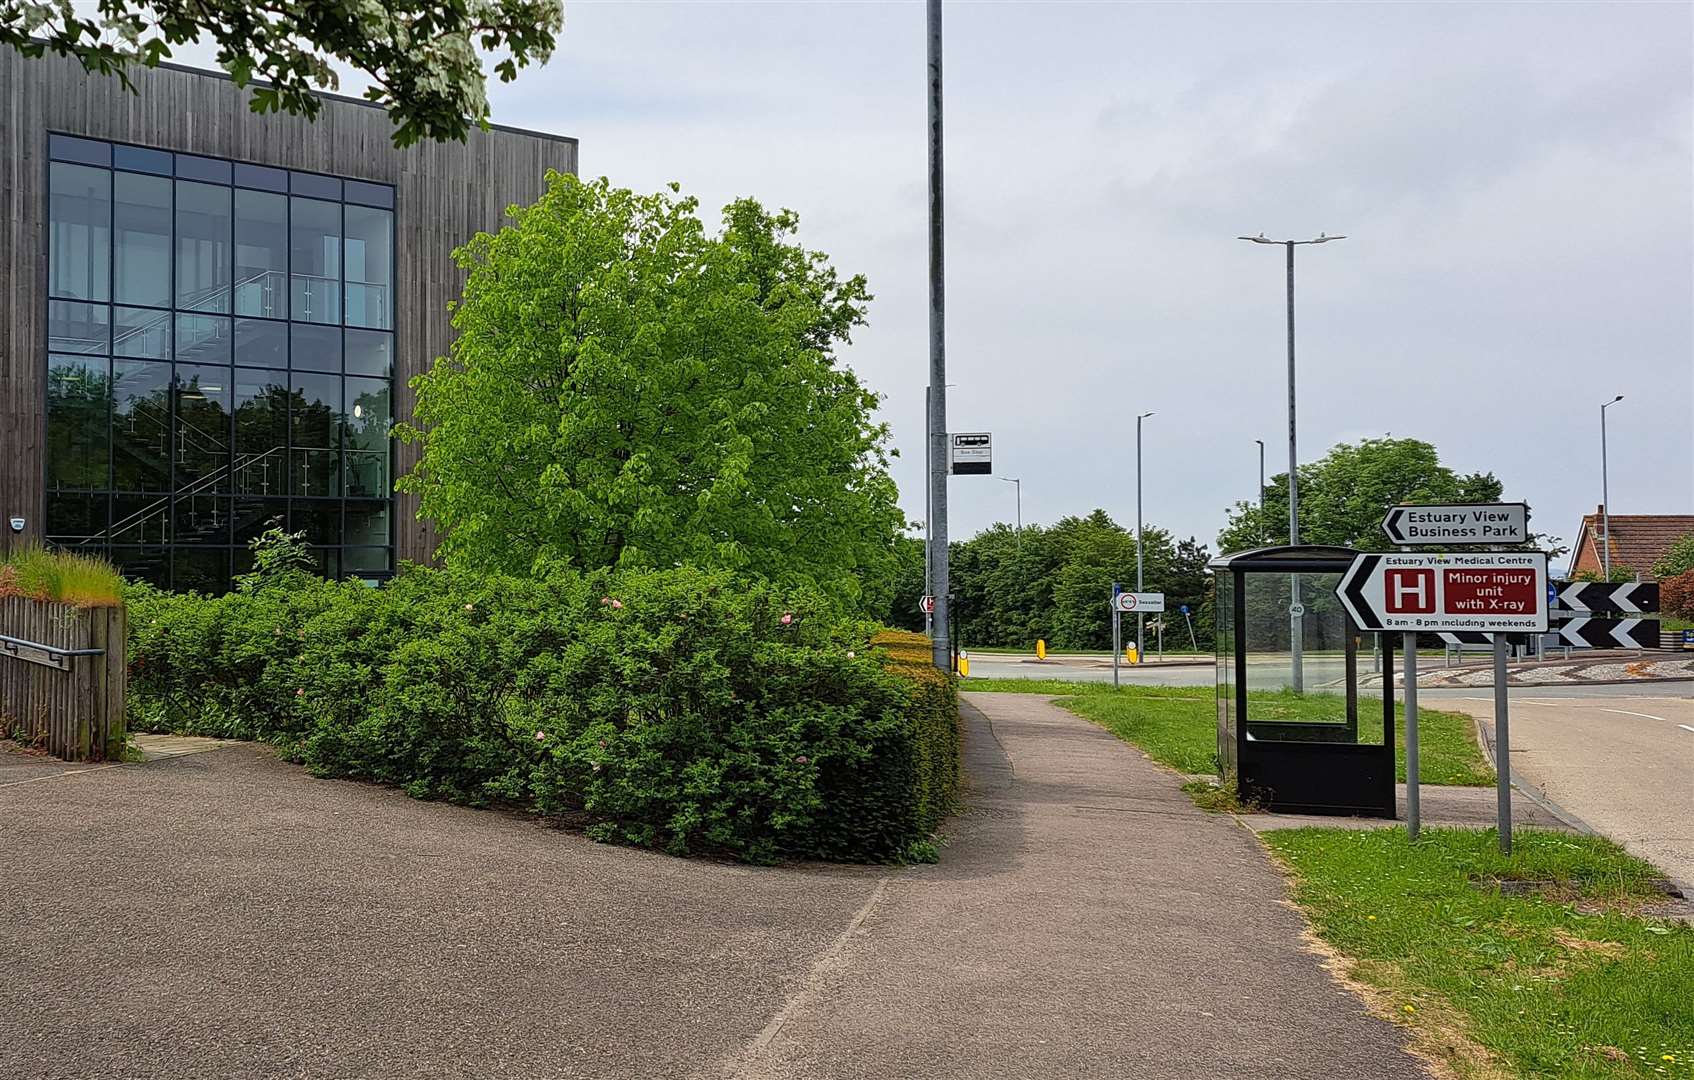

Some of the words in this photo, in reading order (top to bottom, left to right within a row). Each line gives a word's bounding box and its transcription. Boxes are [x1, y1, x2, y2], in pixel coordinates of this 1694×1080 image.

[1408, 511, 1467, 525] Estuary
[1472, 511, 1510, 522] View
[1408, 525, 1477, 537] Business
[1482, 525, 1518, 536] Park
[1386, 557, 1423, 566] Estuary
[1427, 557, 1451, 565] View
[1455, 556, 1494, 565] Medical
[1498, 556, 1533, 565] Centre
[1449, 573, 1488, 584] Minor
[1492, 573, 1531, 586] injury
[1394, 574, 1426, 609] H
[1476, 586, 1504, 597] unit
[1455, 599, 1485, 610] with
[1489, 599, 1525, 611] X-ray
[1442, 618, 1486, 628] including
[1488, 619, 1537, 627] weekends
